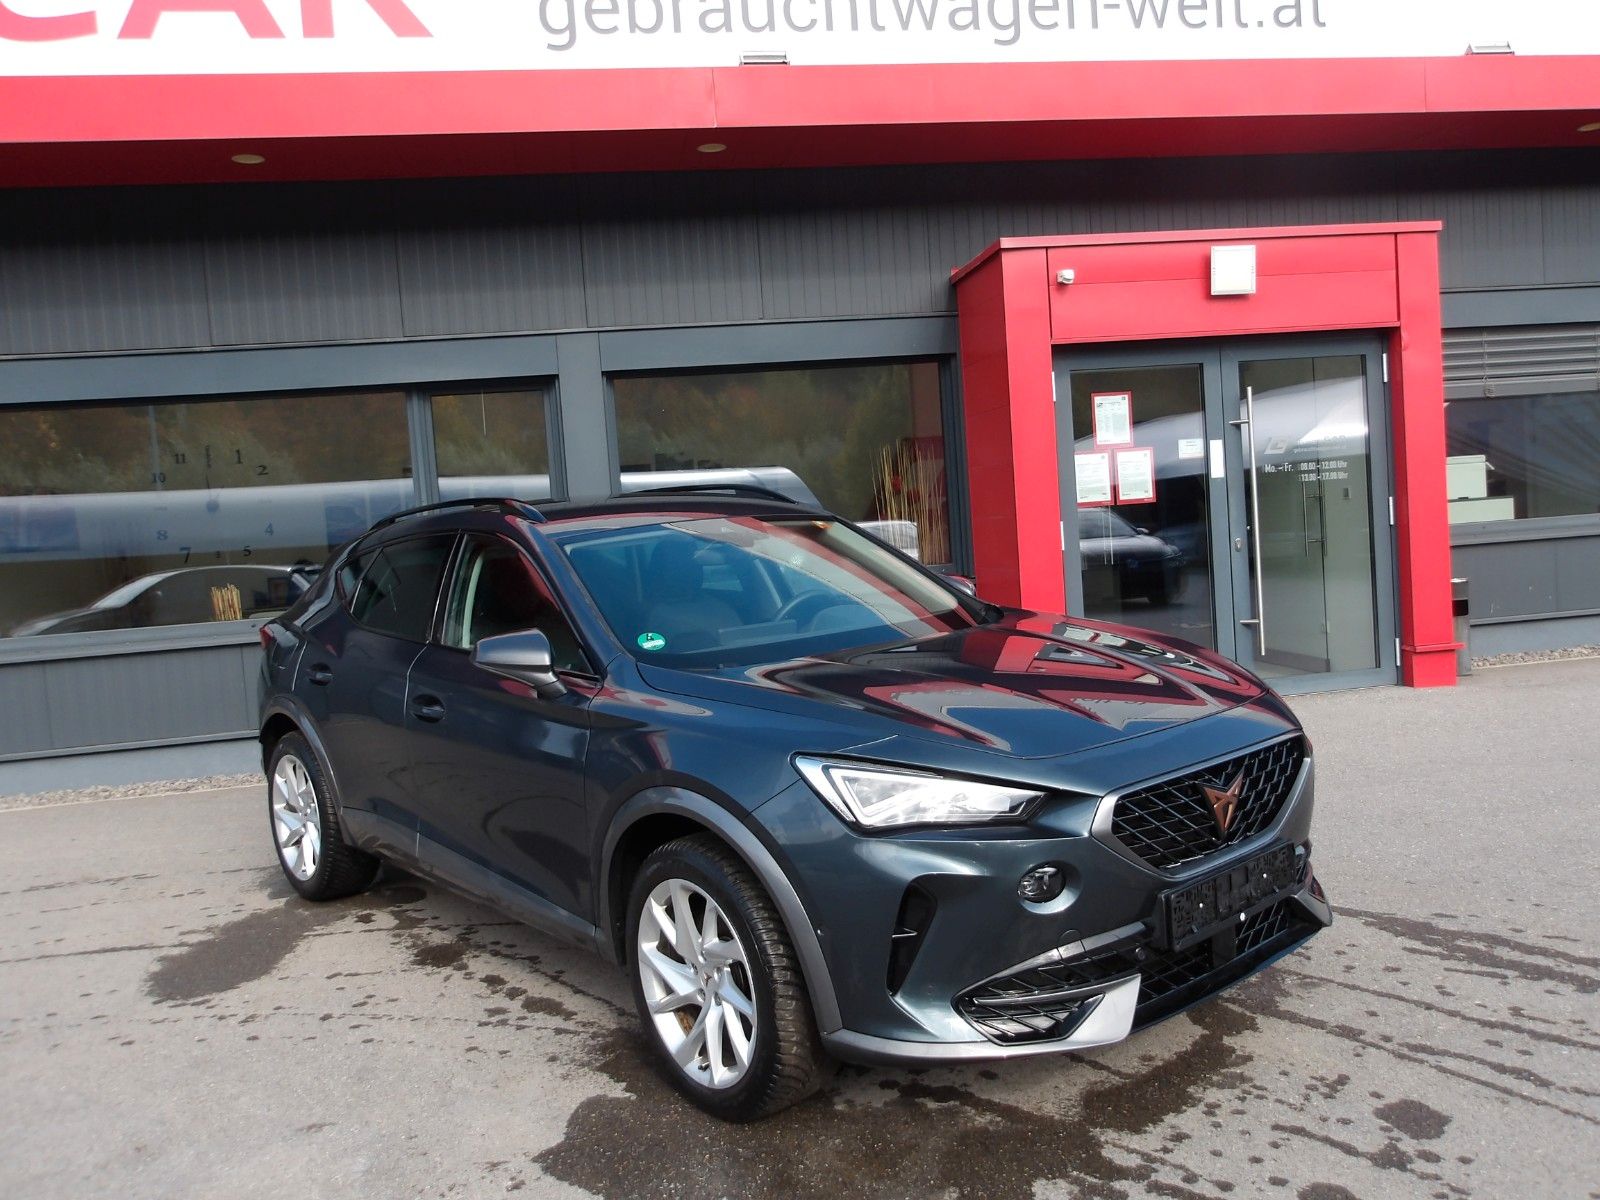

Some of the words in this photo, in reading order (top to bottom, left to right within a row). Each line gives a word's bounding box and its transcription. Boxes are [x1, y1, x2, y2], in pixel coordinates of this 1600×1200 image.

[175, 453, 186, 465] 11
[255, 464, 270, 476] 2
[1284, 462, 1294, 472] Fr.
[156, 529, 169, 541] 8
[180, 546, 192, 565] 7
